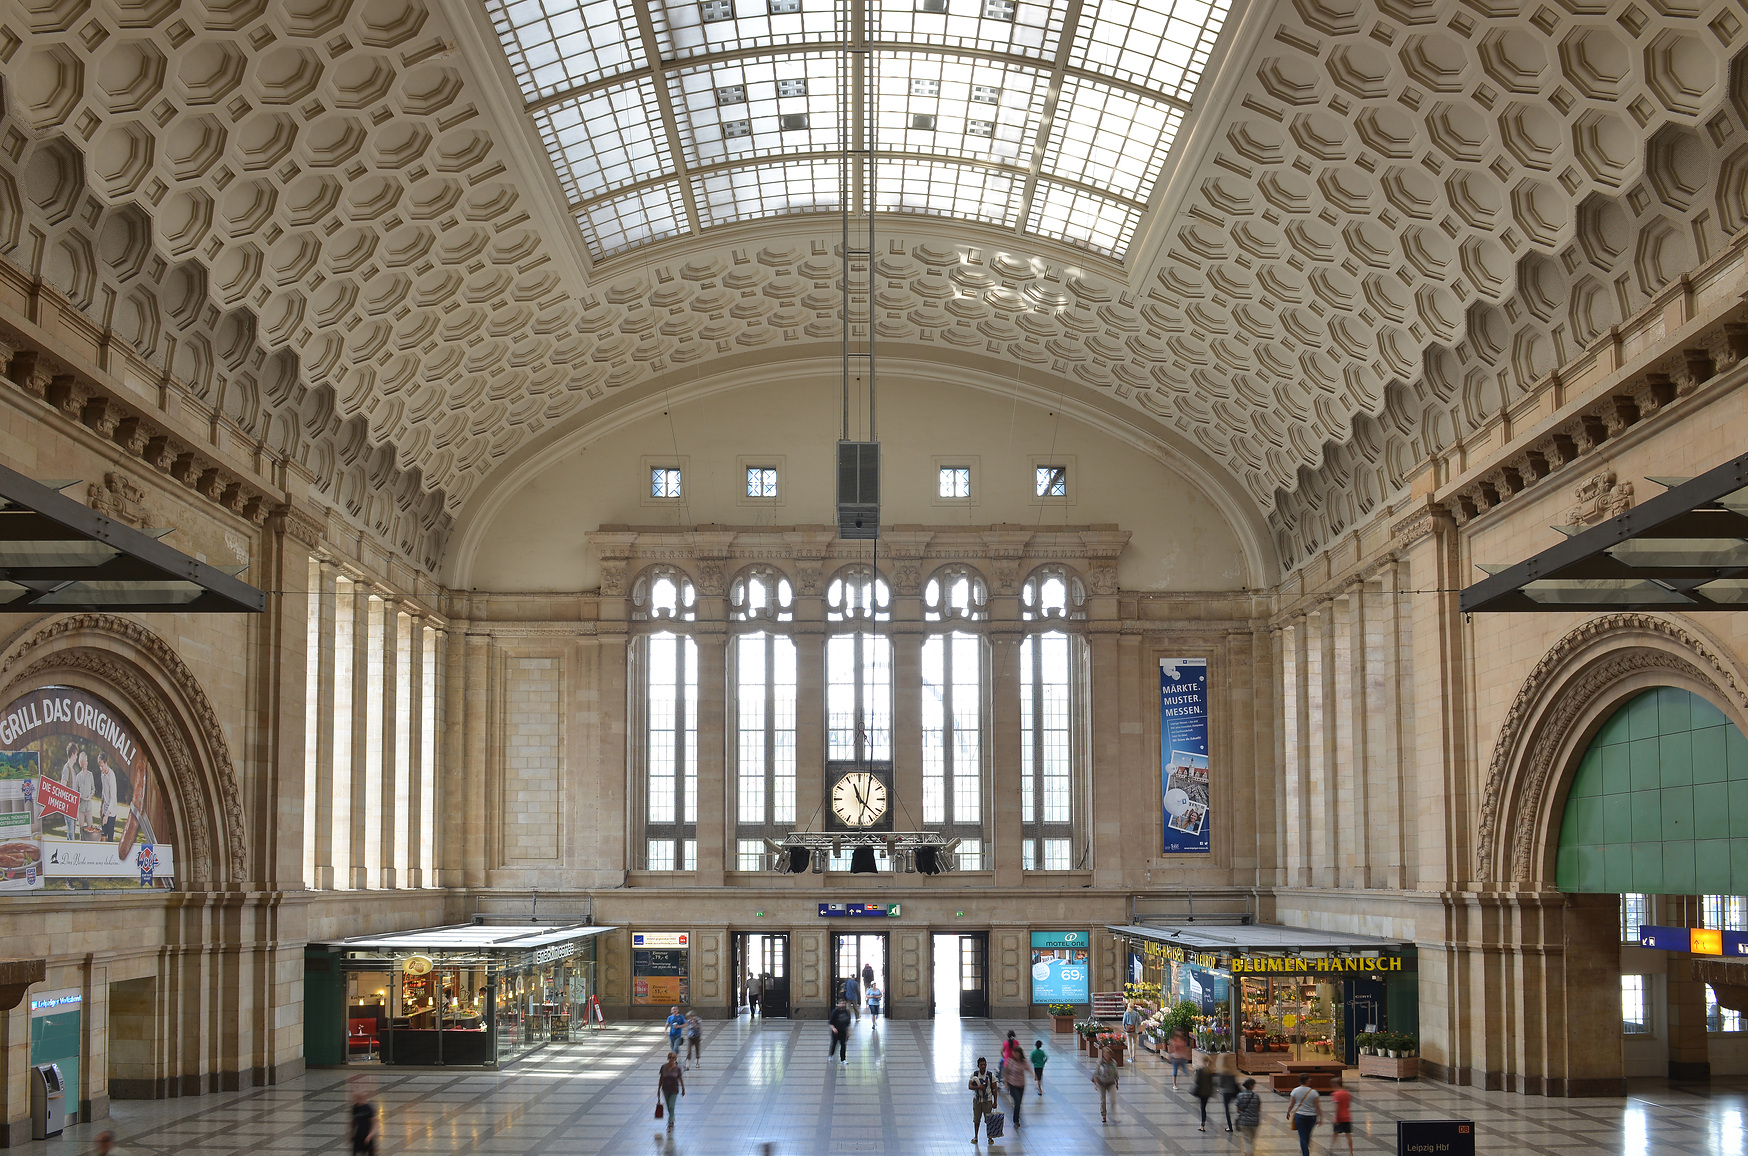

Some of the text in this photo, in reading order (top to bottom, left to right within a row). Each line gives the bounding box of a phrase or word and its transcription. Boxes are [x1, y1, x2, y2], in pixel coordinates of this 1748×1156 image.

[1162, 683, 1201, 694] MÄRKTE.
[1164, 694, 1202, 705] MUSTER.
[1165, 705, 1203, 717] MESSEN.
[0, 698, 137, 766] GRILL DAS ORIGINAL!
[42, 781, 78, 804] DIE SCHMECKT
[48, 796, 66, 812] IMMER
[1194, 953, 1217, 970] FLEUROP
[1231, 956, 1402, 973] BLUMEN-HANISCH
[1407, 1143, 1450, 1153] Leipzig Hbf
